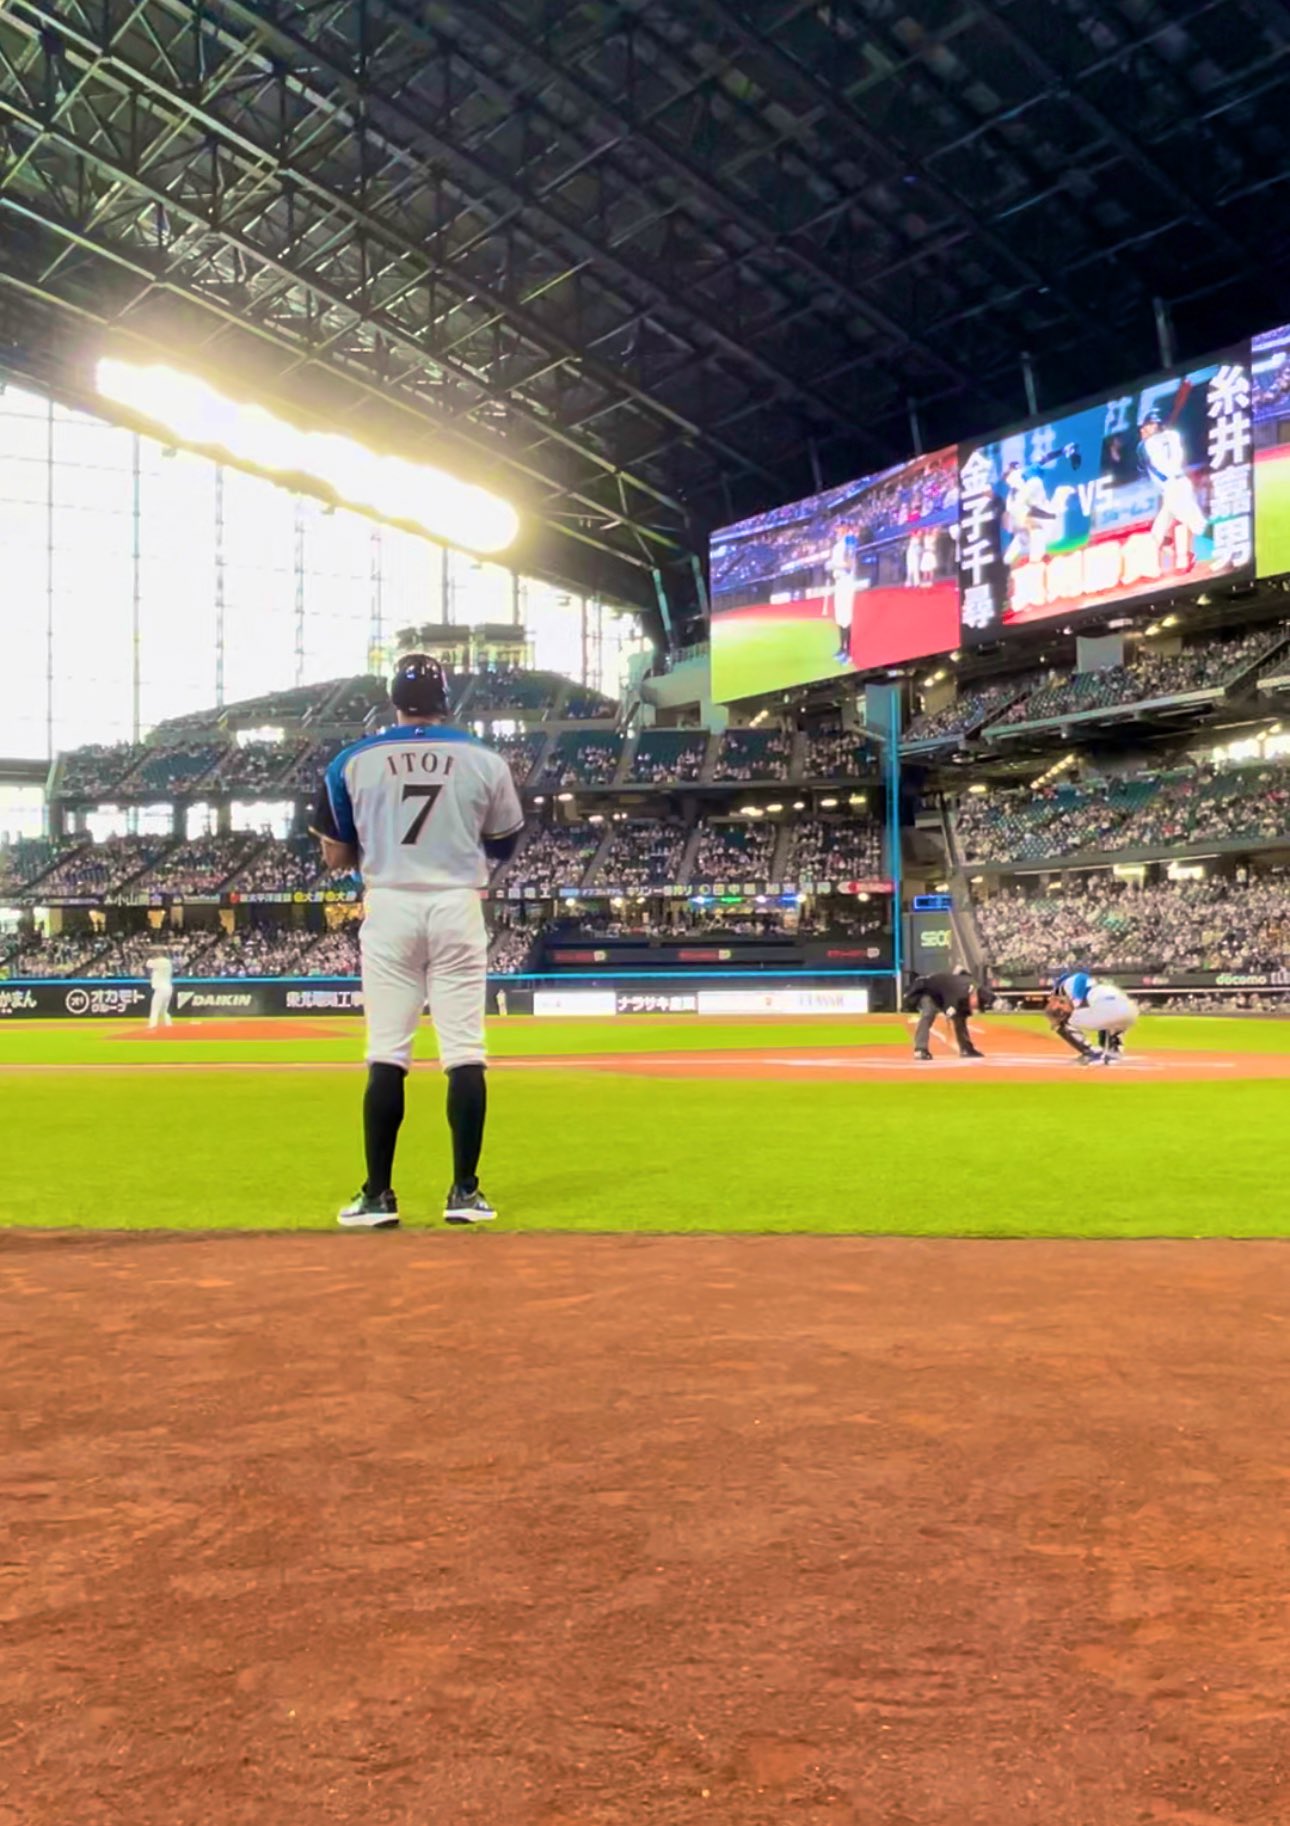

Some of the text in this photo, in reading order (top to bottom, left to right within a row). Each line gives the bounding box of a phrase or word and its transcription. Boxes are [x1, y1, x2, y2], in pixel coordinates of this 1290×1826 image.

[387, 751, 454, 775] ITOI
[401, 783, 444, 845] 7
[1216, 973, 1267, 985] docomo
[90, 989, 146, 1004] オカモト
[192, 994, 252, 1007] DAIKIN
